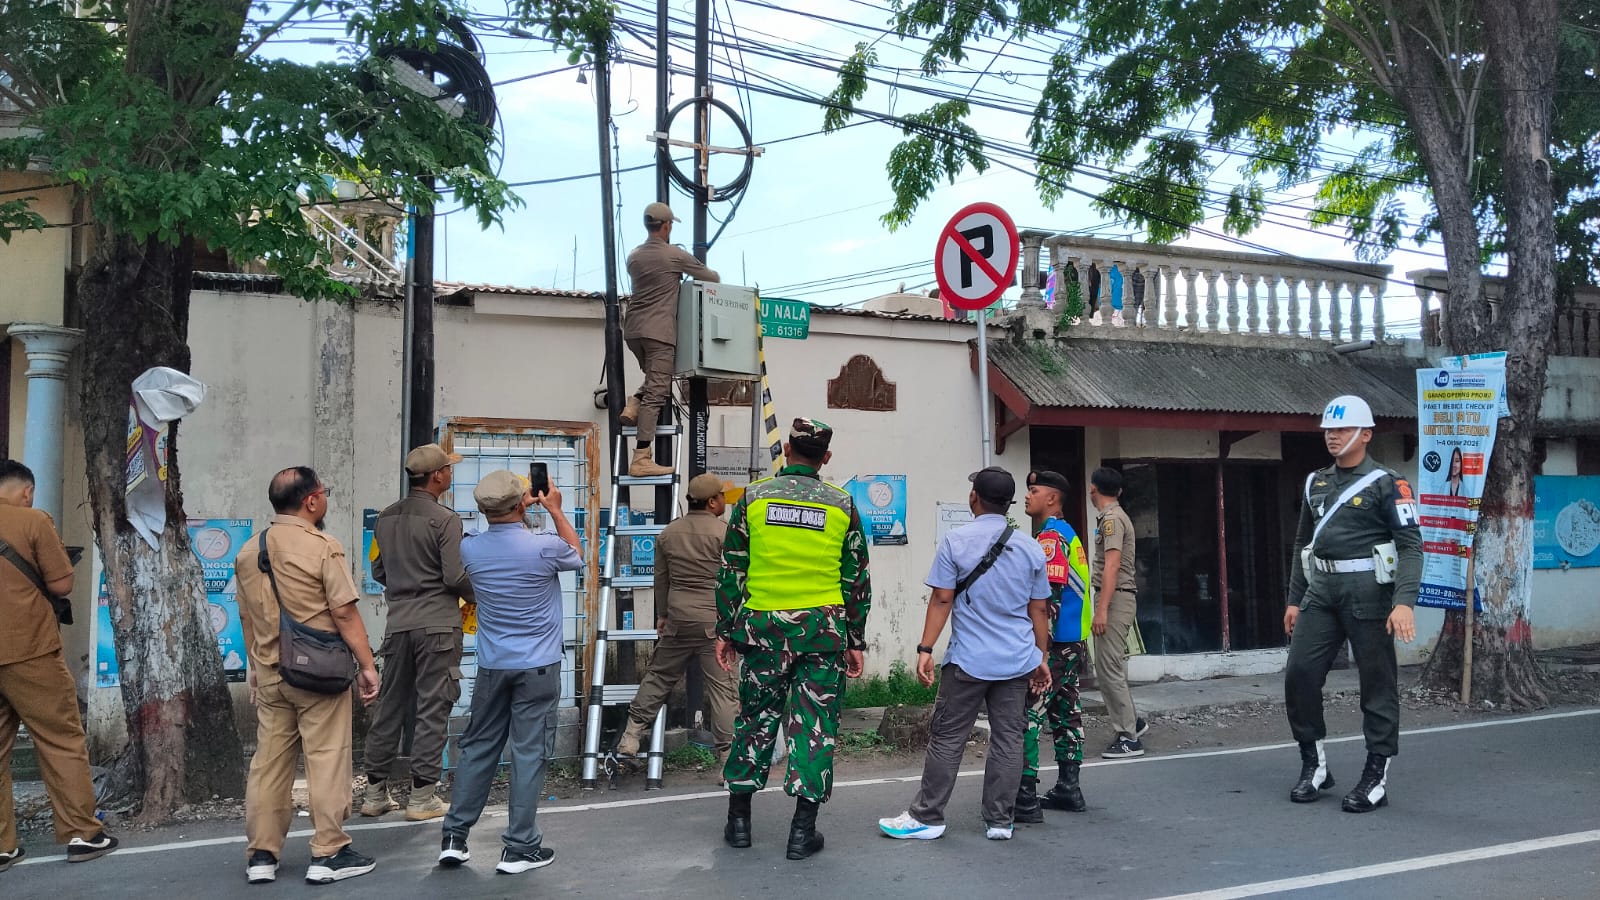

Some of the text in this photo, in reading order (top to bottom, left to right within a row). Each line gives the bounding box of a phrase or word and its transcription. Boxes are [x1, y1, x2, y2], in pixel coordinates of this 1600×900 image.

[960, 224, 994, 289] P
[774, 303, 807, 321] NALA
[777, 325, 803, 337] 61316
[1427, 391, 1447, 399] GRAND
[1325, 405, 1346, 420] PM
[231, 519, 251, 527] BARU
